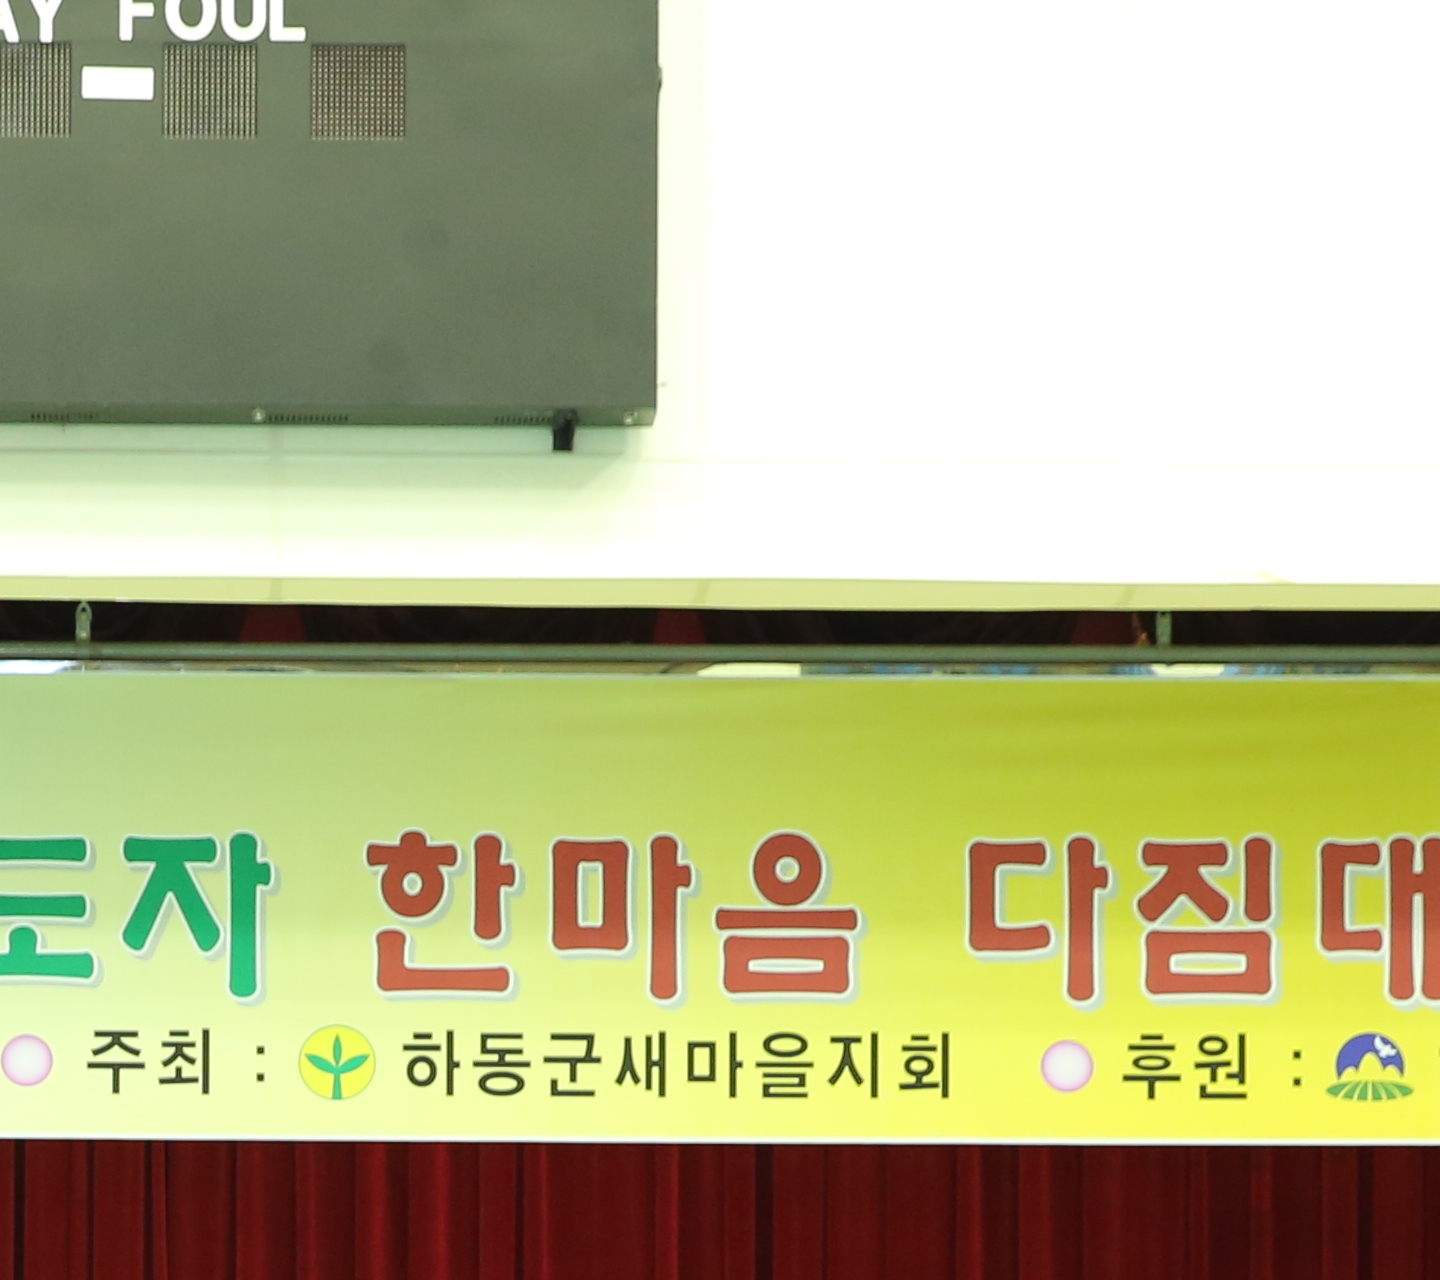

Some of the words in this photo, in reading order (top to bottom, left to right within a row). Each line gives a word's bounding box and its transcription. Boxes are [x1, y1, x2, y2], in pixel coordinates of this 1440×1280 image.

[118, 0, 308, 43] FOUL
[367, 830, 859, 1001] 한마음
[86, 1027, 213, 1097] 주최
[402, 1029, 952, 1102] 하동군새마을지회
[1122, 1033, 1250, 1102] 후원
